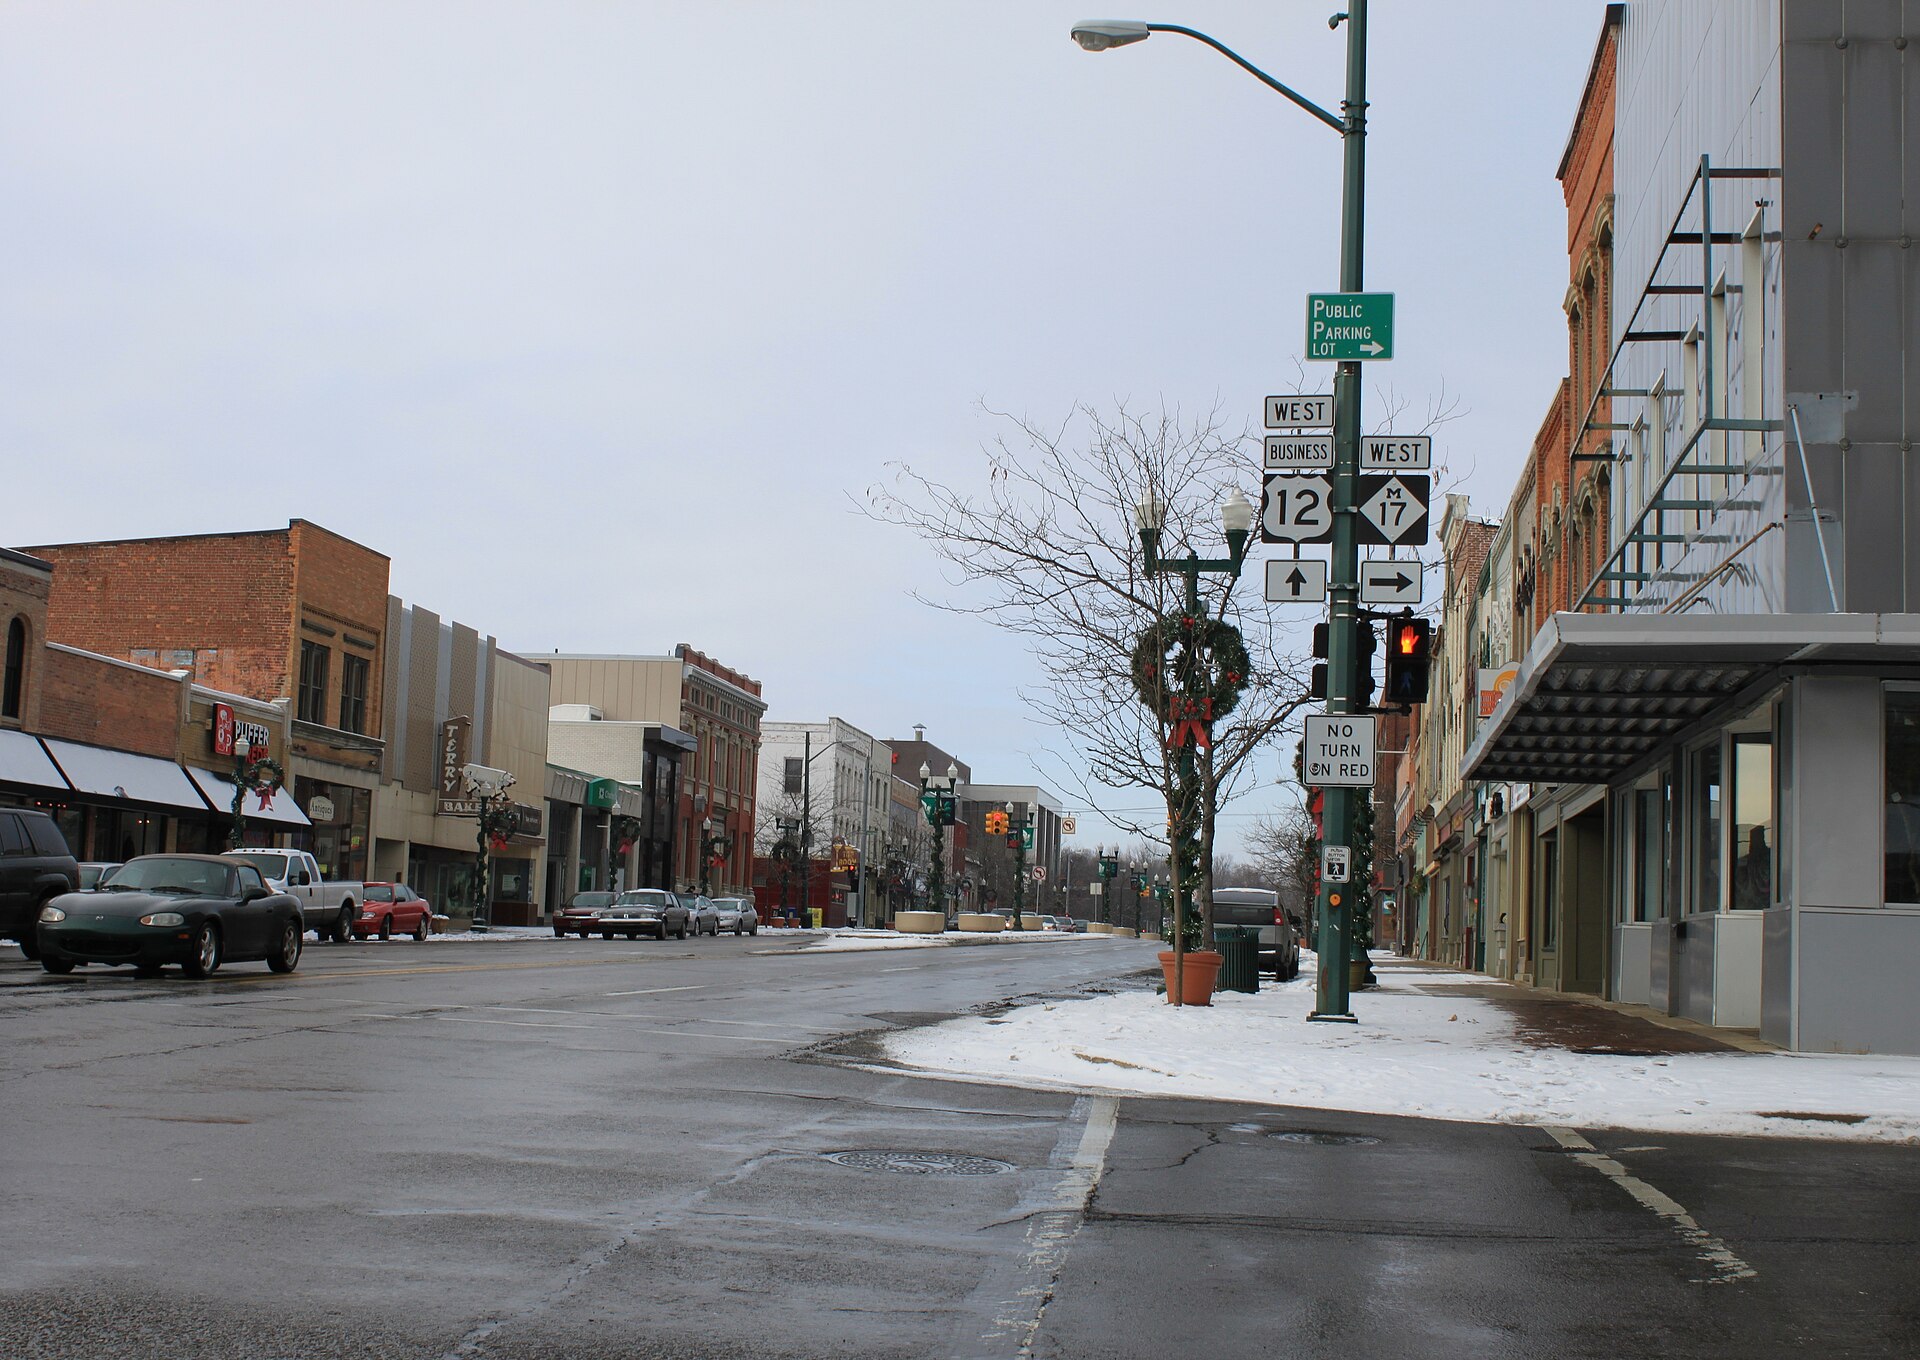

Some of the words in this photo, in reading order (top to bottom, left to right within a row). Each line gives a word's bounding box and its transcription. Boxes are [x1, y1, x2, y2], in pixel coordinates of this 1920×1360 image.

[1313, 299, 1363, 318] PUBLIC
[1313, 321, 1372, 340] PARKING
[1312, 342, 1336, 356] LOT
[1274, 402, 1326, 421] WEST
[1270, 444, 1328, 460] BUSINESS
[1369, 443, 1422, 462] WEST
[1386, 488, 1402, 499] M
[1276, 489, 1320, 526] 12
[1379, 502, 1408, 527] 17
[234, 719, 270, 746] PUFFER
[1327, 724, 1354, 738] NO
[443, 725, 459, 792] TERRY
[1319, 744, 1361, 757] TURN
[1309, 762, 1331, 776] ON
[1339, 764, 1369, 777] RED
[311, 802, 333, 818] Antiques
